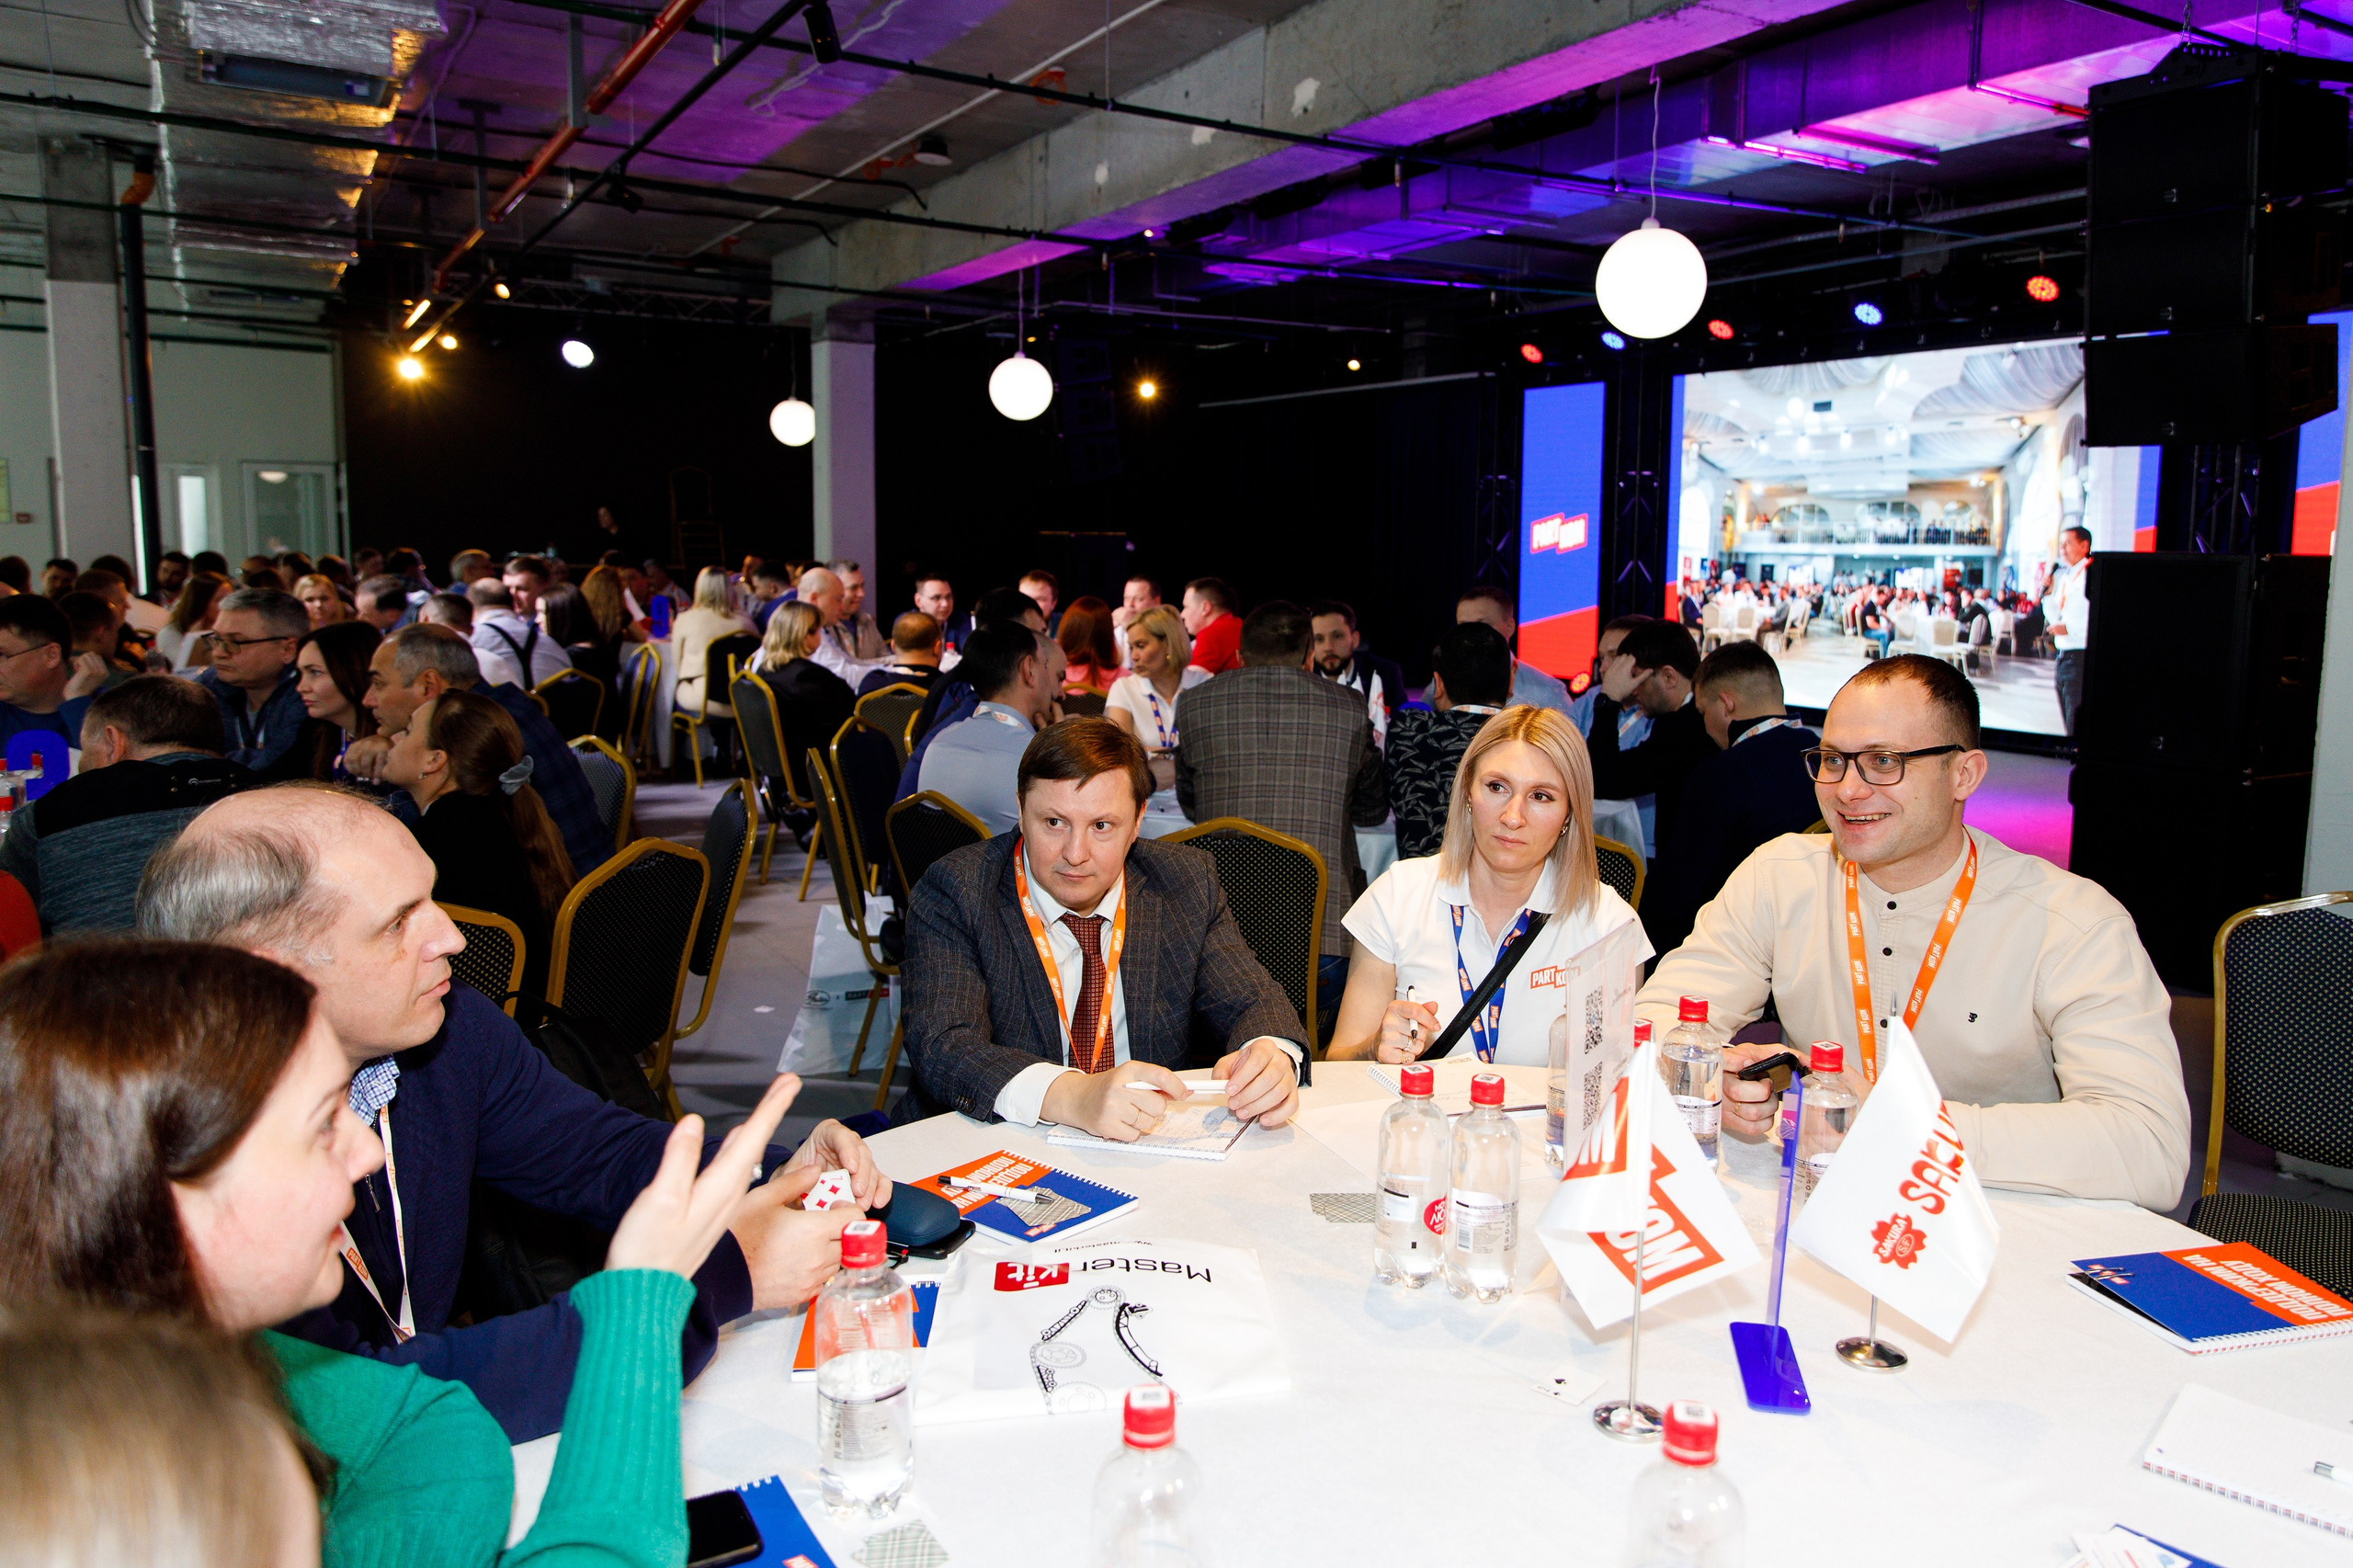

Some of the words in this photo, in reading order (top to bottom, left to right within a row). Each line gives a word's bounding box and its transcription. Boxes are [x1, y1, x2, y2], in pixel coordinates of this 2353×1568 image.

[1532, 968, 1556, 986] PART
[1878, 1218, 1908, 1257] SAKURA
[1074, 1257, 1212, 1283] Master
[2182, 1254, 2218, 1267] НА
[2219, 1260, 2281, 1283] ХОДУ
[2202, 1266, 2328, 1320] ПОДДЕРЖИМ
[2265, 1280, 2353, 1316] ПОЛНОМ
